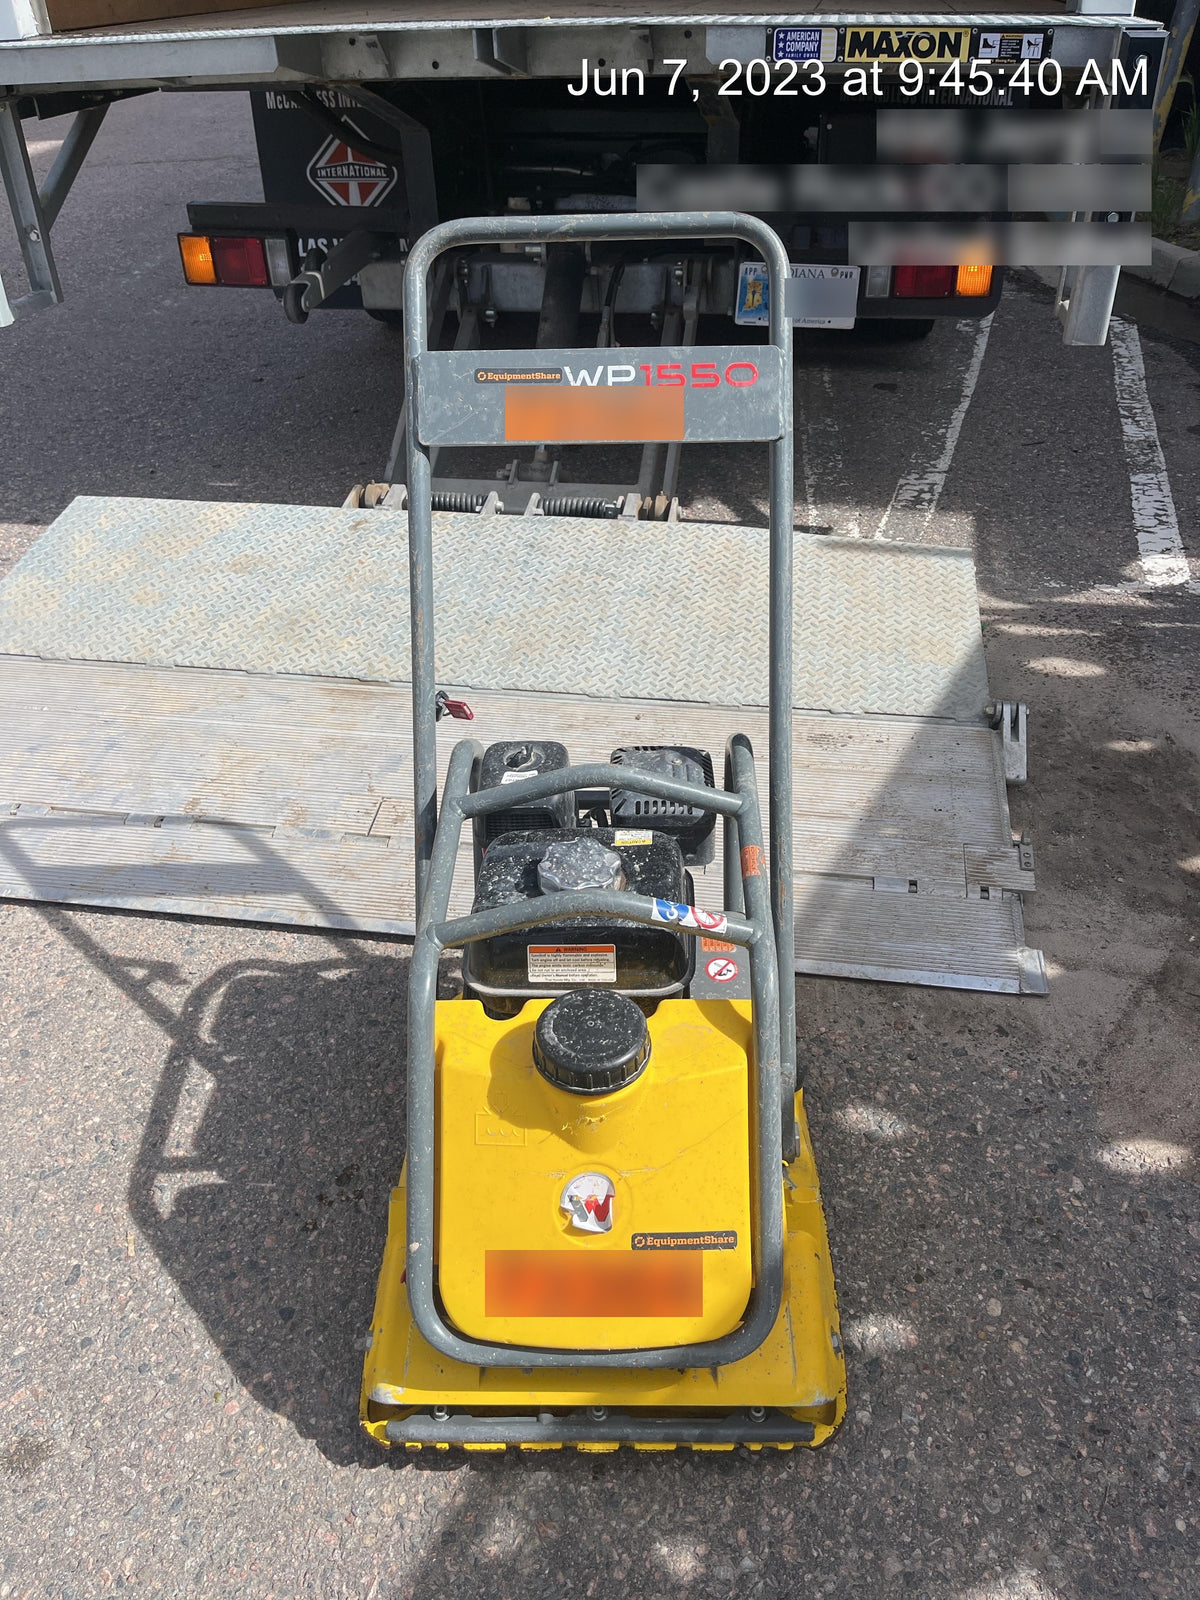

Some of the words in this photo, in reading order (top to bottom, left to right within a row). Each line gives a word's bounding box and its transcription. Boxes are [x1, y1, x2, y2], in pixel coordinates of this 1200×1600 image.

[786, 31, 820, 41] AMERICAN
[785, 41, 819, 52] COMPANY
[847, 31, 963, 58] MAXON
[317, 166, 387, 178] INTERNATIONAL
[487, 371, 561, 382] EquipmentShare
[563, 361, 759, 389] WP1550
[646, 1235, 735, 1247] EquipmentShare
